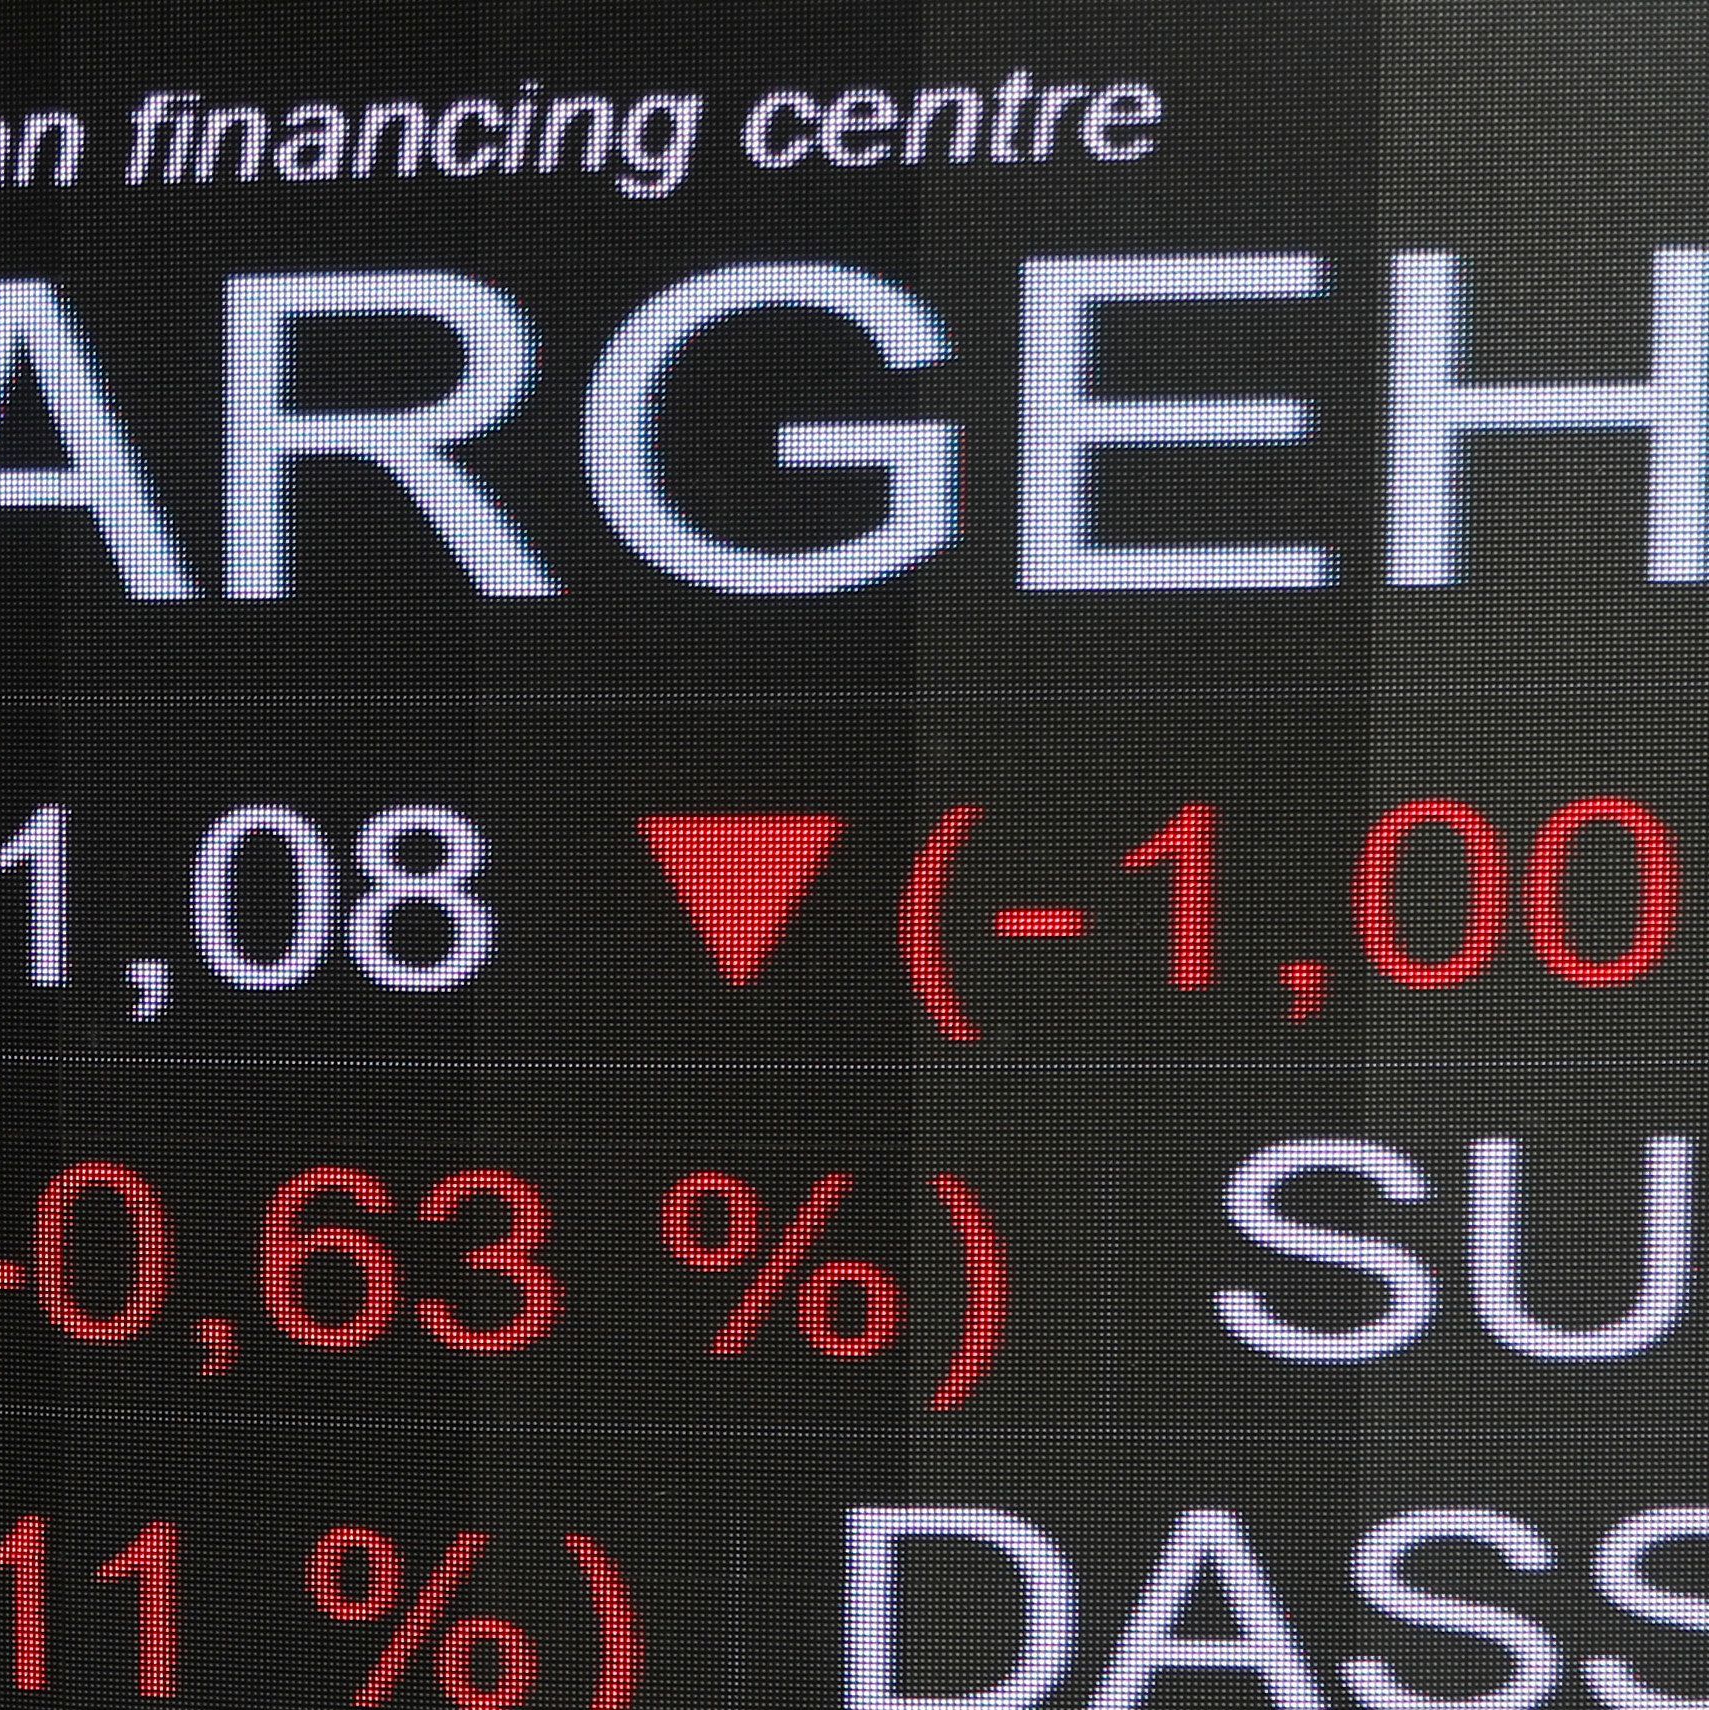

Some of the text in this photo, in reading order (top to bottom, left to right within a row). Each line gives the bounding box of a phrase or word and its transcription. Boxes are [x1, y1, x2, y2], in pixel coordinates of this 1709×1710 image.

[126, 92, 703, 199] financing
[742, 69, 1163, 168] centre
[898, 794, 1680, 1042] (-1,00
[660, 1168, 1010, 1411] %)
[1217, 1135, 1691, 1362] SU
